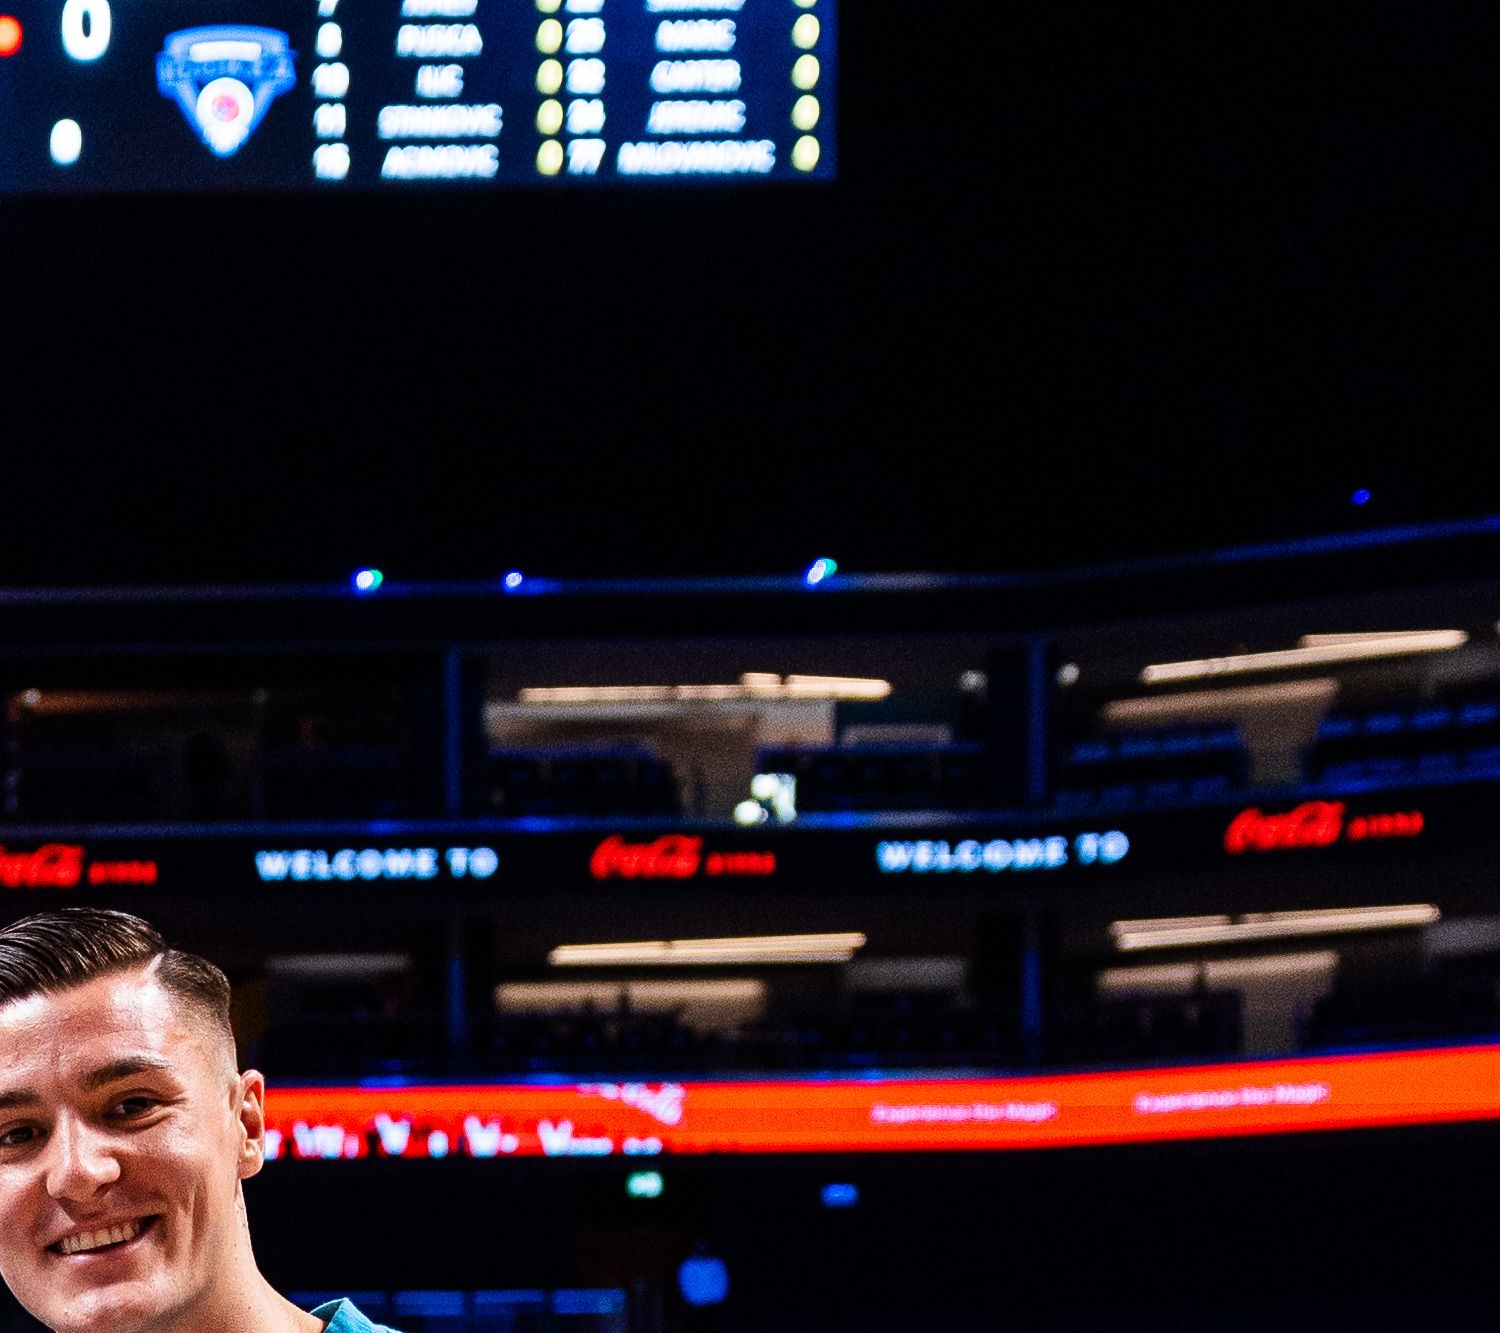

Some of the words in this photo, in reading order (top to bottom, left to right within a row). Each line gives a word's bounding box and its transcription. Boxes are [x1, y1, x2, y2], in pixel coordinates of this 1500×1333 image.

[255, 847, 438, 881] WELCOME
[447, 846, 499, 877] TO
[878, 835, 1067, 871] WELCOME
[1076, 830, 1130, 863] TO
